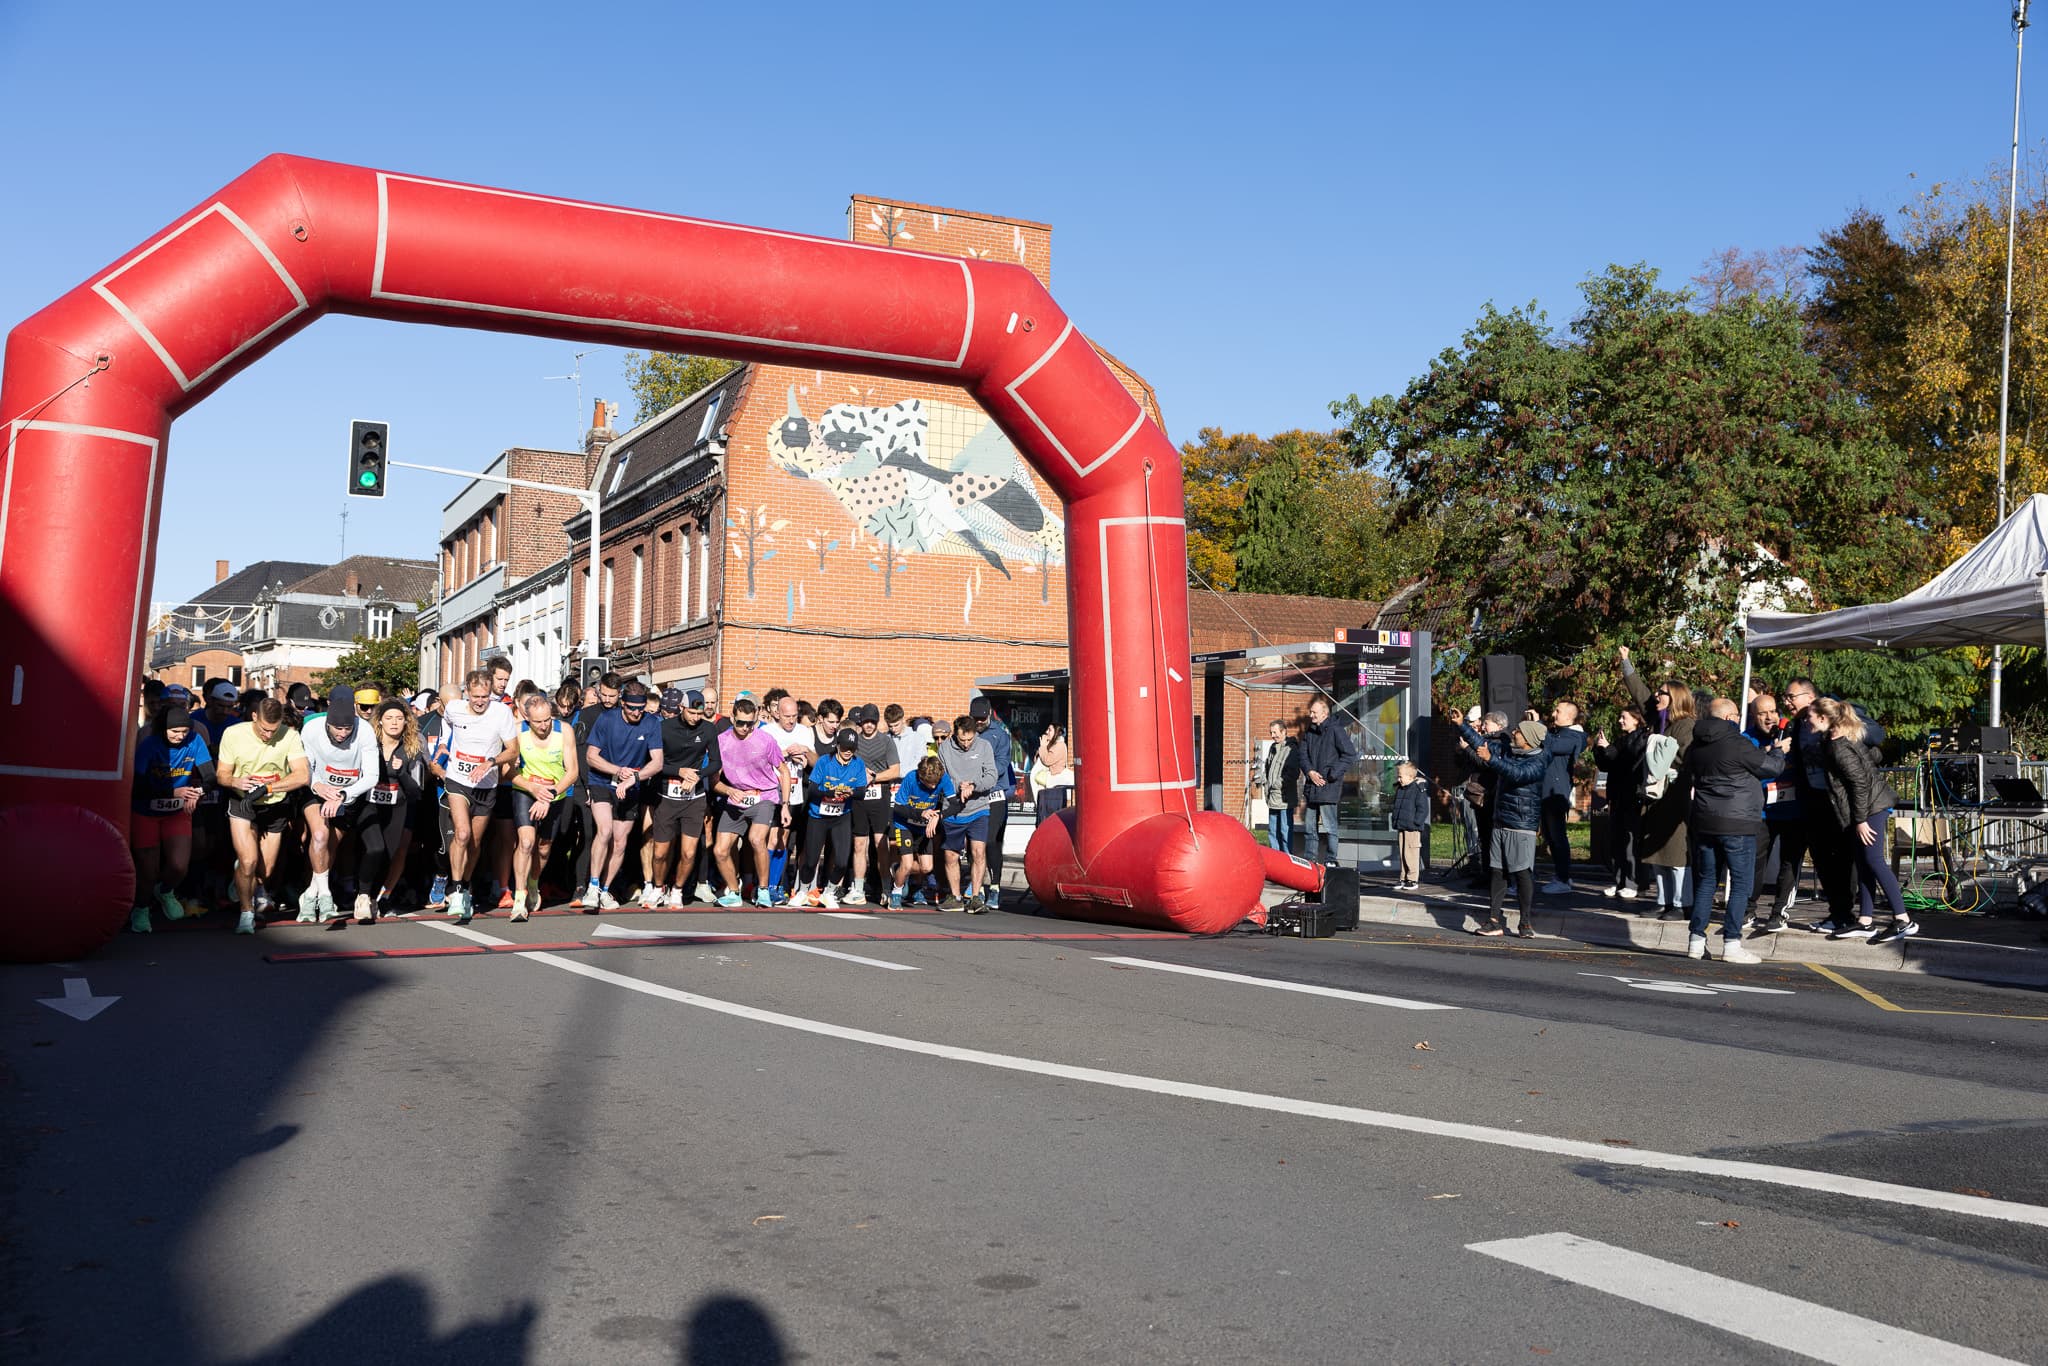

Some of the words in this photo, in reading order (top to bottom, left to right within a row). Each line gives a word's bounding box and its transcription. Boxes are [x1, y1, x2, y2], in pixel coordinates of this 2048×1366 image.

[1362, 645, 1385, 654] Mairie
[329, 775, 352, 784] 697
[372, 791, 393, 801] 539
[157, 800, 179, 809] 540
